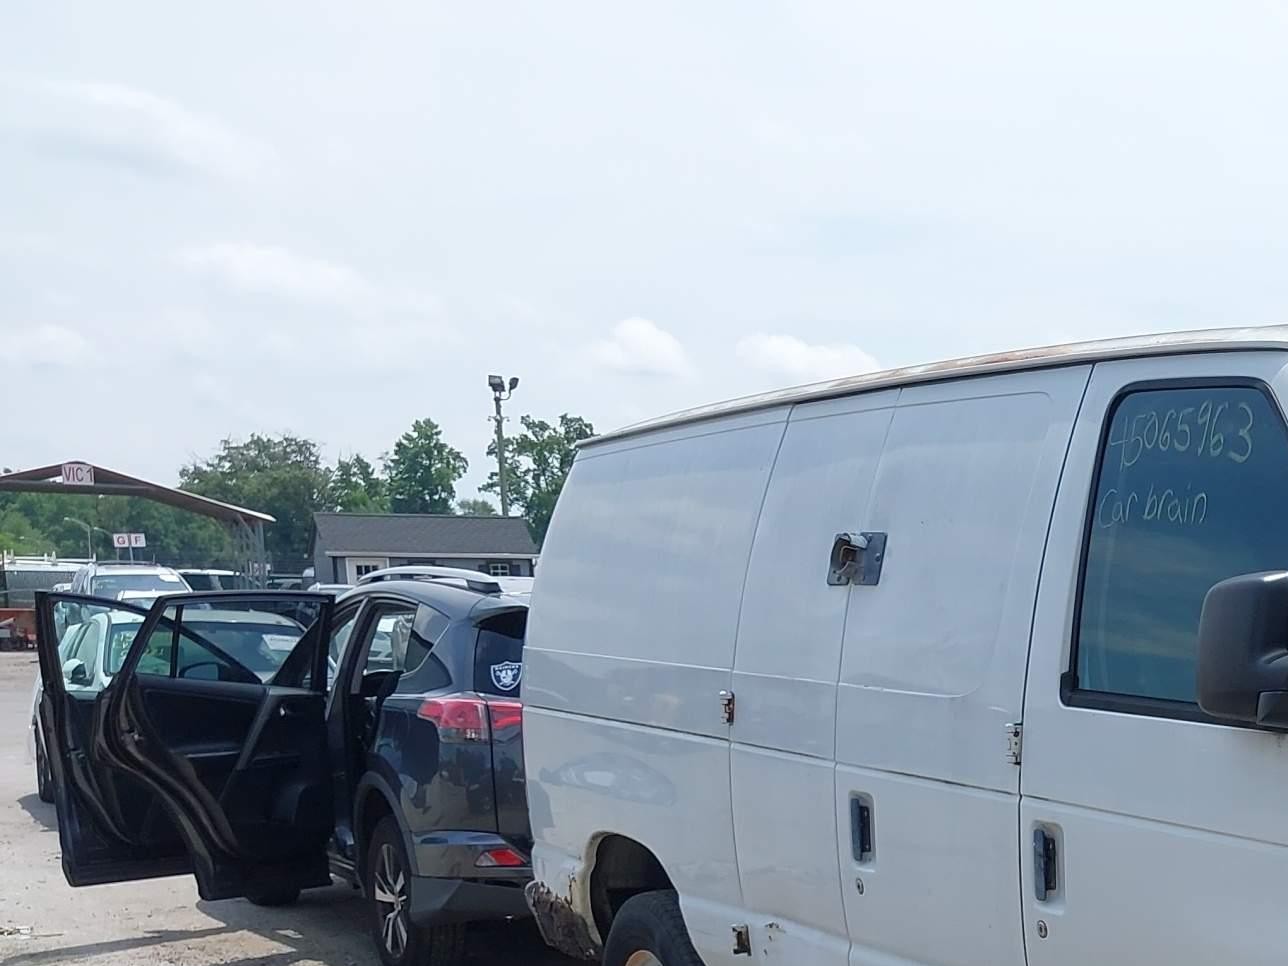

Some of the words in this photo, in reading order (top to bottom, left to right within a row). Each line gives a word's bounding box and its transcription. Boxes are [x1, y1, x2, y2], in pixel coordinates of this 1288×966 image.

[1109, 400, 1253, 472] 45065963
[63, 466, 84, 482] VIC
[87, 467, 94, 482] 1
[134, 536, 141, 545] F
